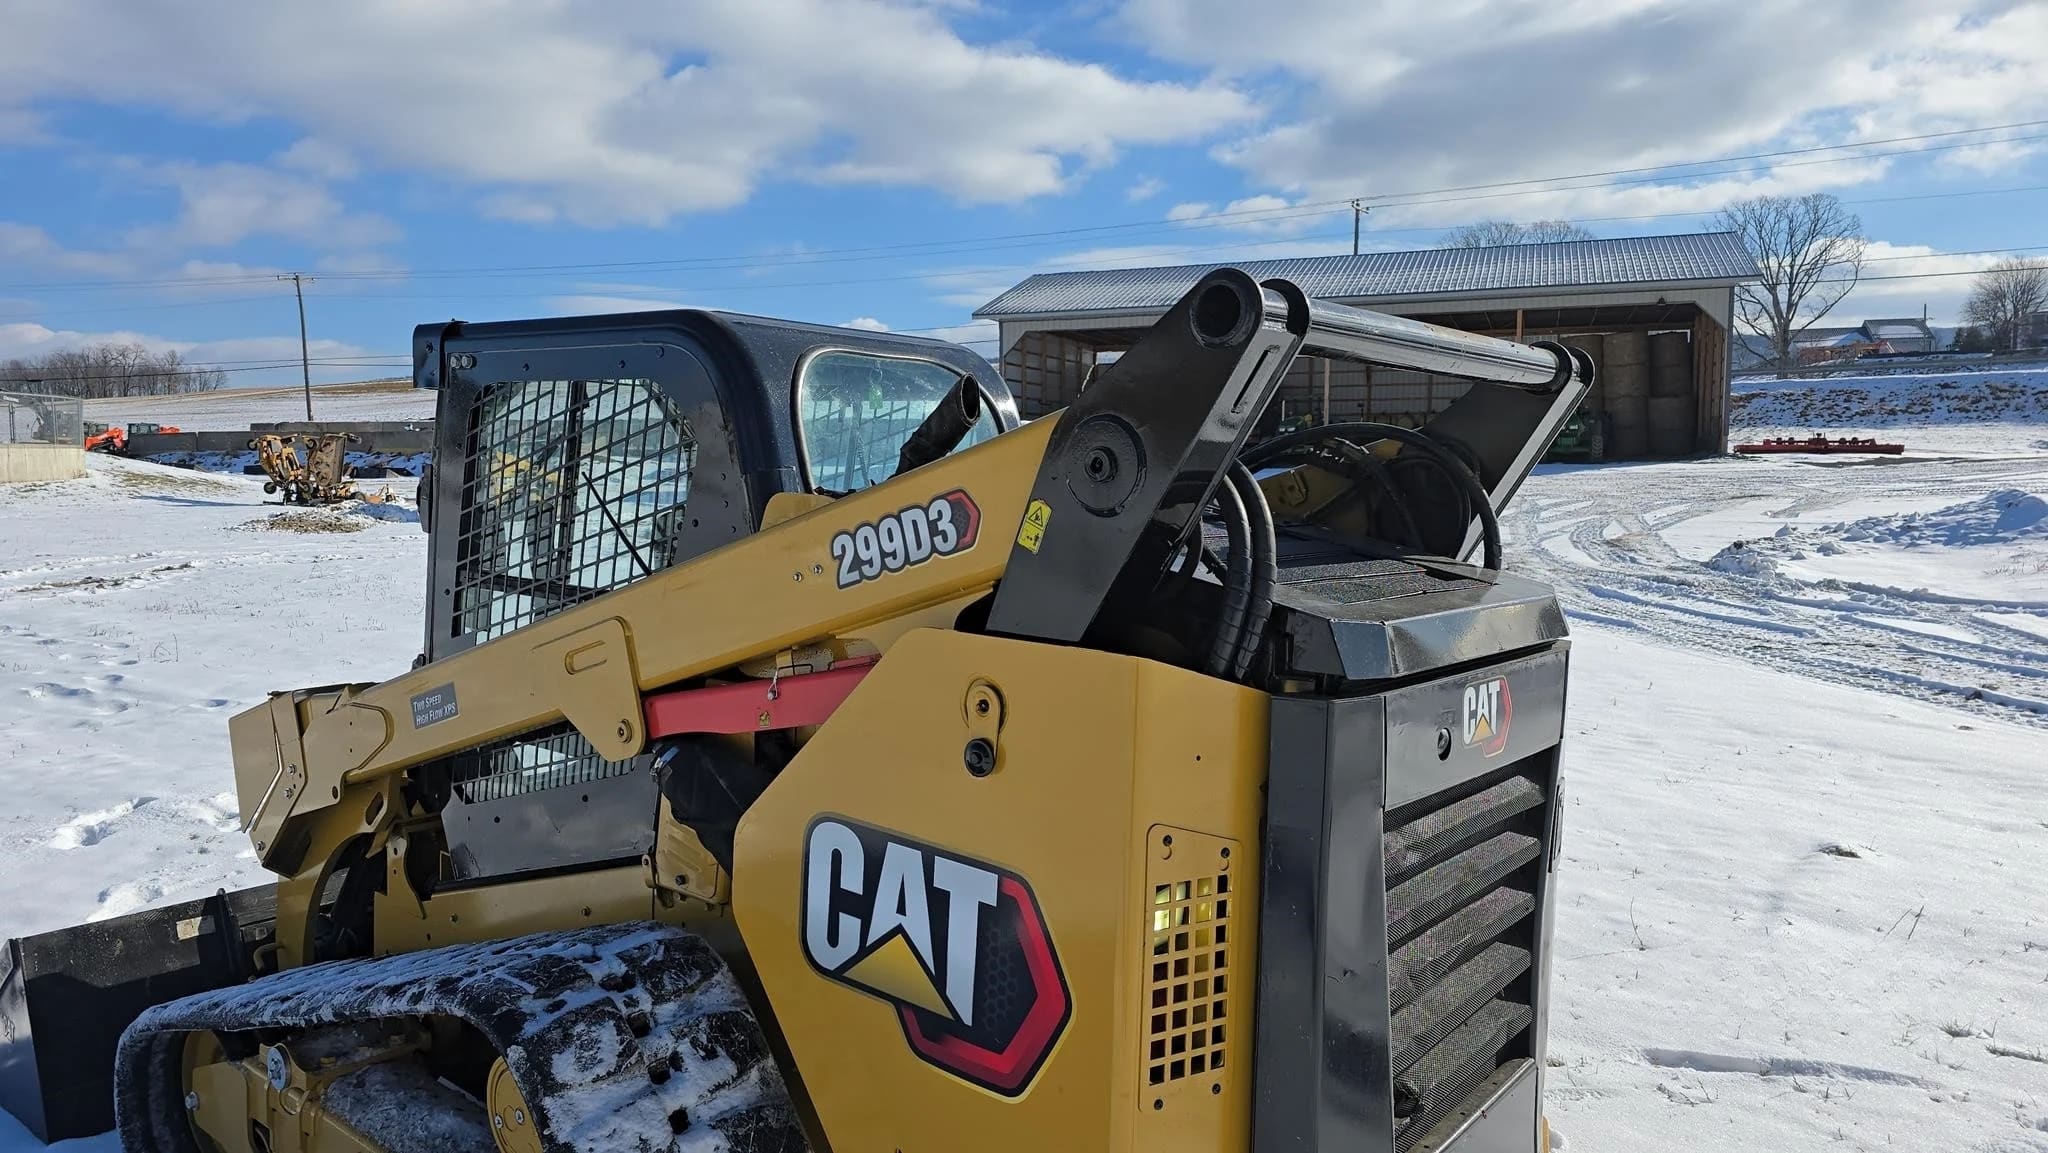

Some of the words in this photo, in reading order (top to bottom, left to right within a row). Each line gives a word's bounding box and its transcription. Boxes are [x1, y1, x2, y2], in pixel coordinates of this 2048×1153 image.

[833, 499, 958, 585] 299D3
[444, 702, 456, 716] XPS
[1463, 679, 1500, 745] CAT
[806, 821, 998, 1027] CAT
